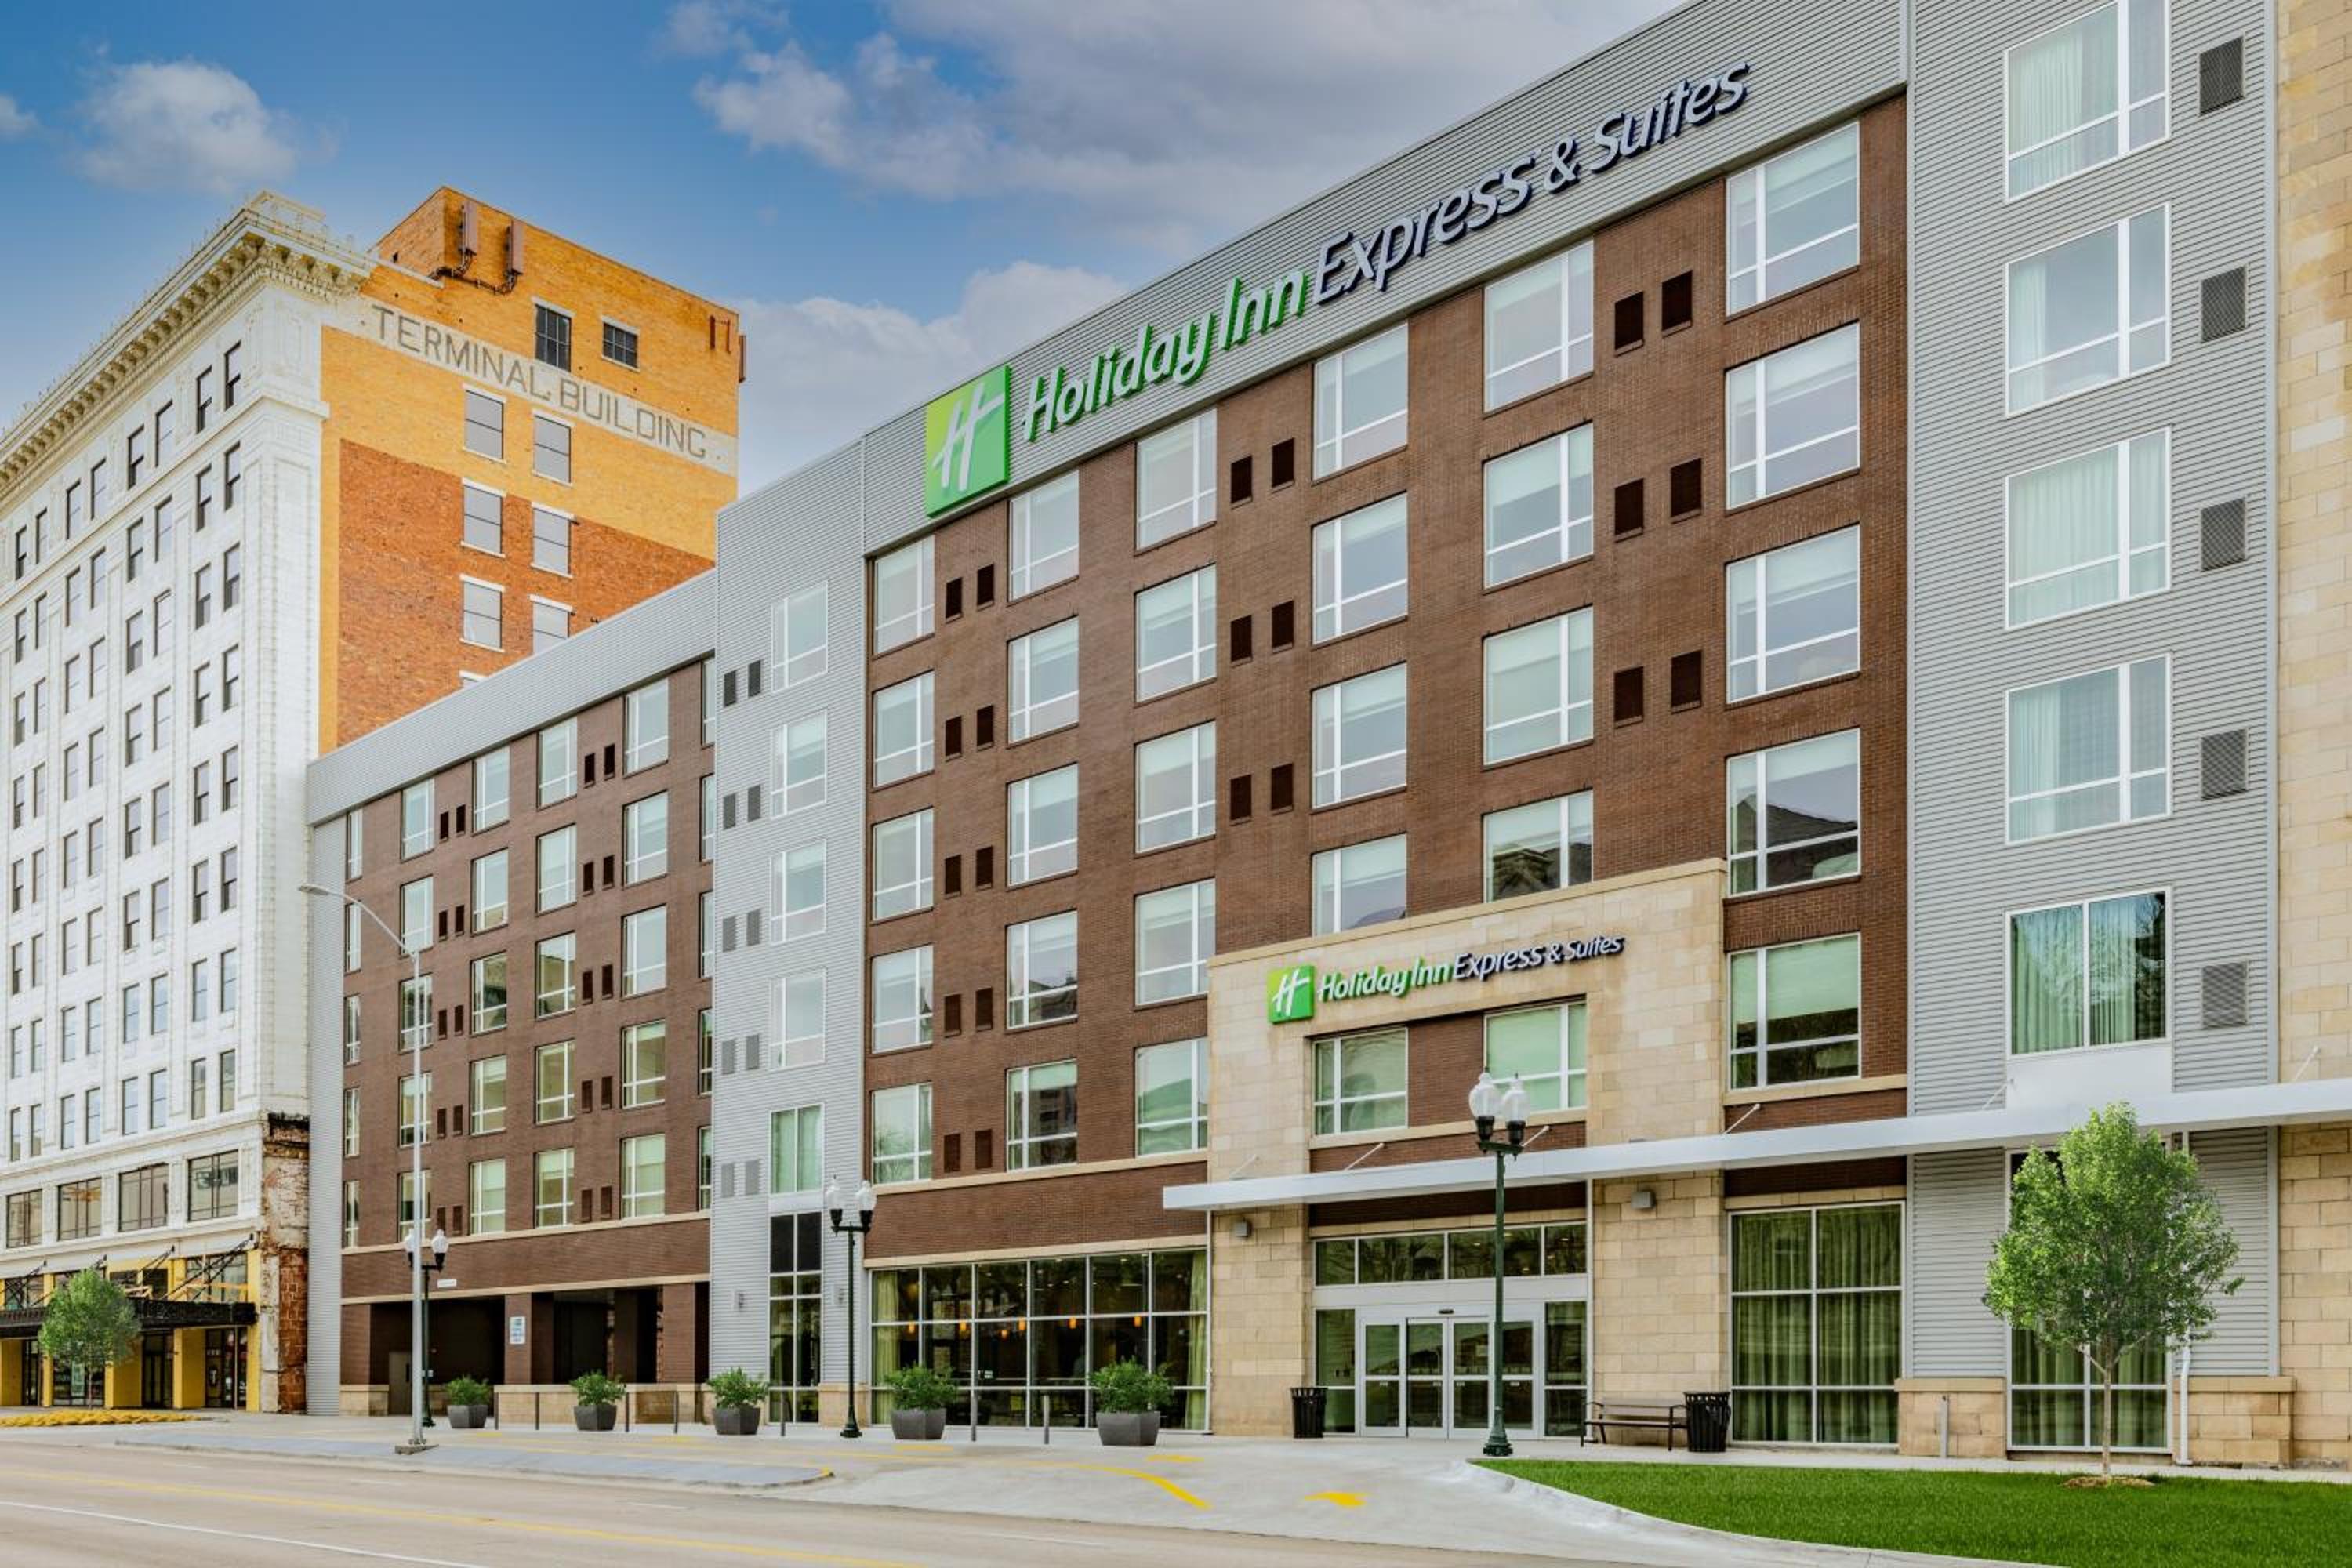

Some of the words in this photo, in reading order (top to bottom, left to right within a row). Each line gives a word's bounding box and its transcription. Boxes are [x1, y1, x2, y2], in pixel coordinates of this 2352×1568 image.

[1022, 323, 1217, 442] Holiday
[1218, 270, 1311, 350] Inn
[1312, 151, 1541, 304] Express
[1544, 136, 1581, 194] &
[1589, 61, 1751, 173] Suites
[372, 304, 550, 401] TERMINAL
[559, 376, 707, 460] BUILDING
[1318, 965, 1411, 1002] Holiday
[1411, 956, 1454, 987] Inn
[1453, 946, 1545, 982] Express
[1548, 942, 1563, 964] &
[1564, 935, 1625, 963] Suites
